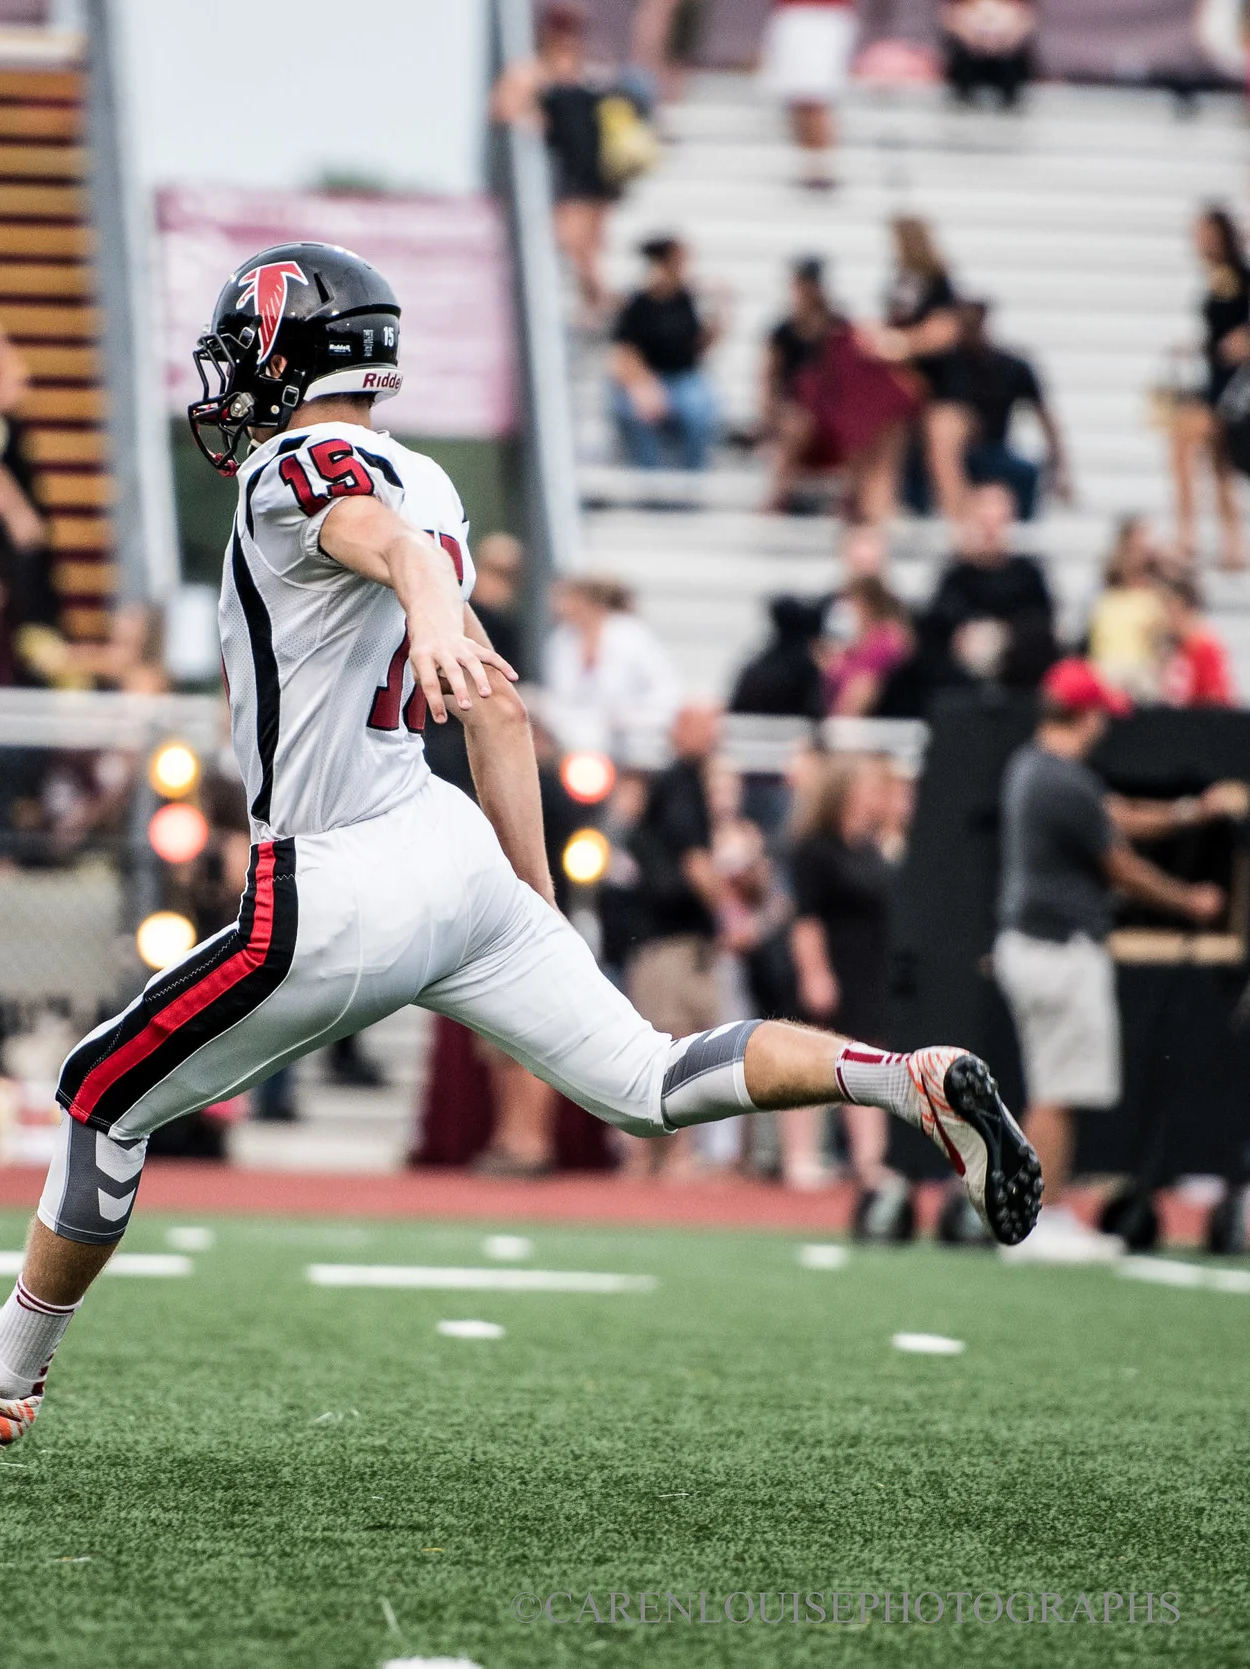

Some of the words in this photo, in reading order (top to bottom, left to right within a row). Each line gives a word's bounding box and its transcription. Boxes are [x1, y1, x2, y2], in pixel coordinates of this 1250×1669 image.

[383, 326, 395, 348] 15
[362, 372, 403, 390] Ridde
[279, 438, 375, 518] 15
